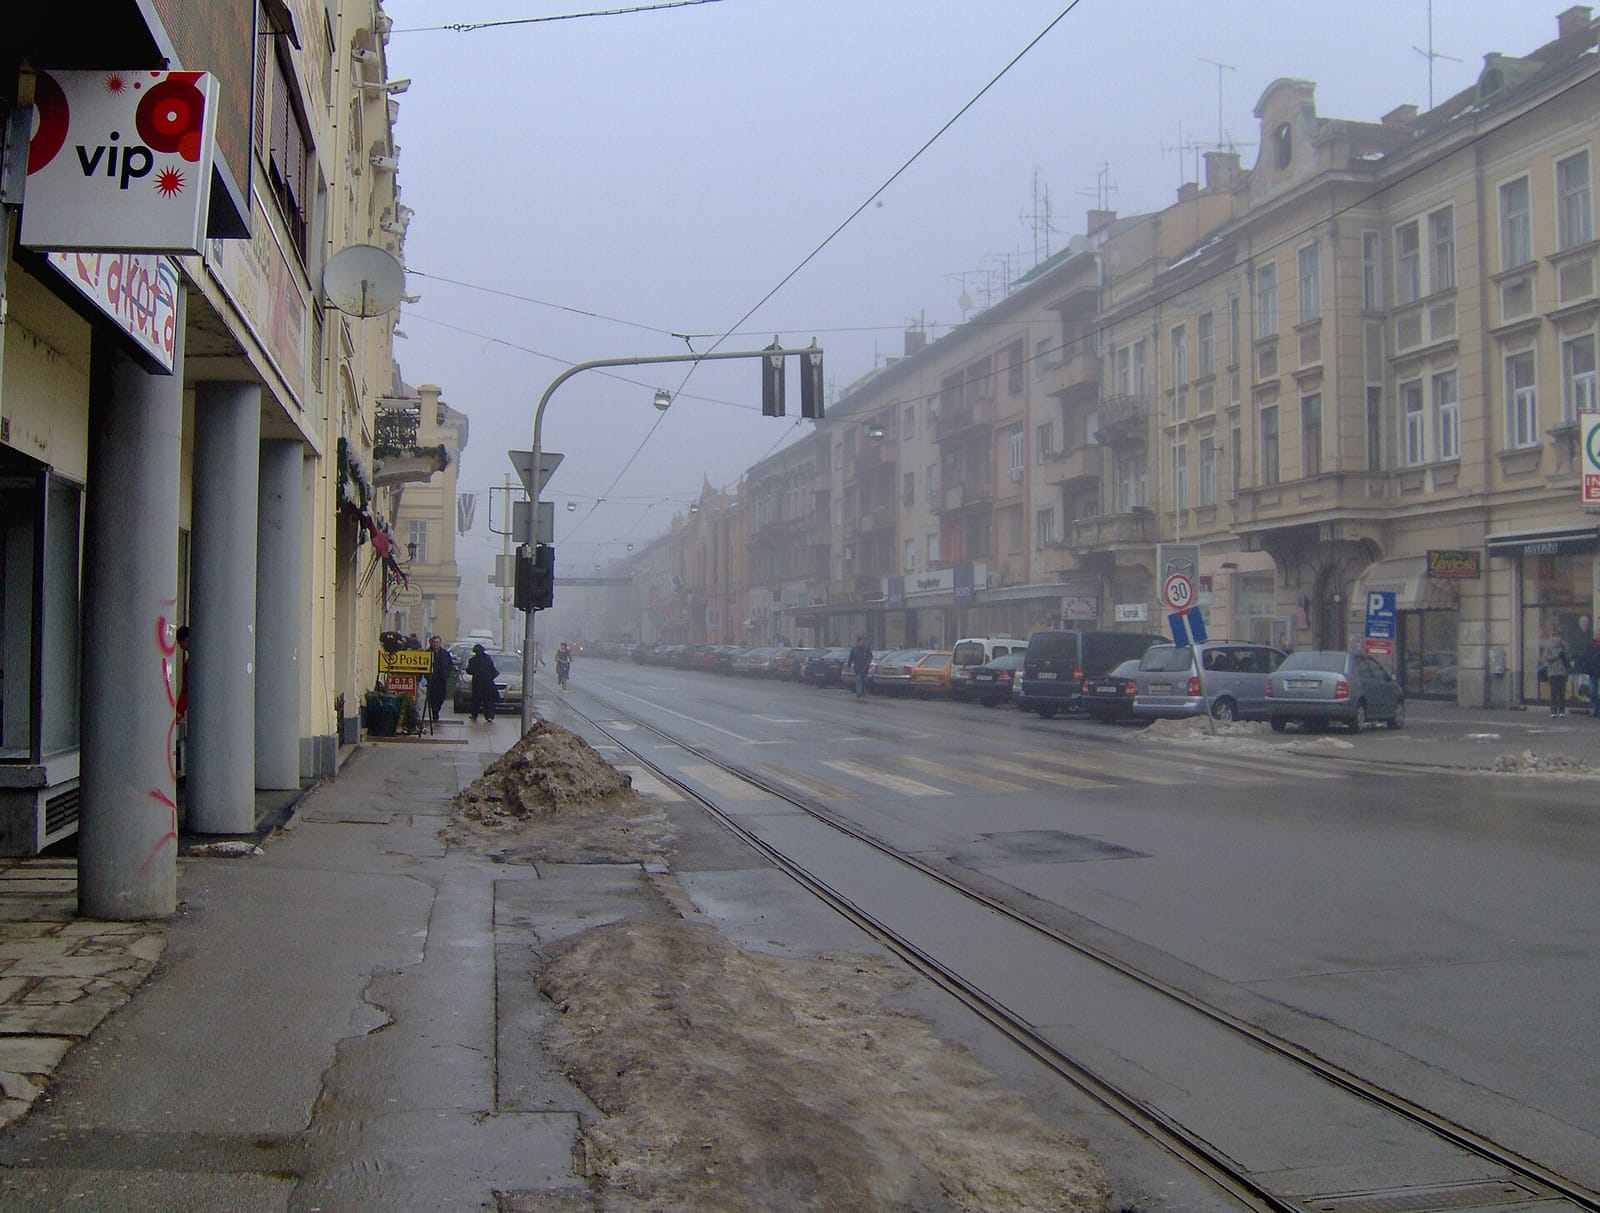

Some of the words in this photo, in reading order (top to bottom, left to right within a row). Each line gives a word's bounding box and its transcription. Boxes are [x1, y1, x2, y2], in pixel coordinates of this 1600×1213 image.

[76, 131, 154, 190] vip
[1170, 582, 1188, 602] 30
[1369, 594, 1384, 616] P
[400, 654, 430, 666] Pošta
